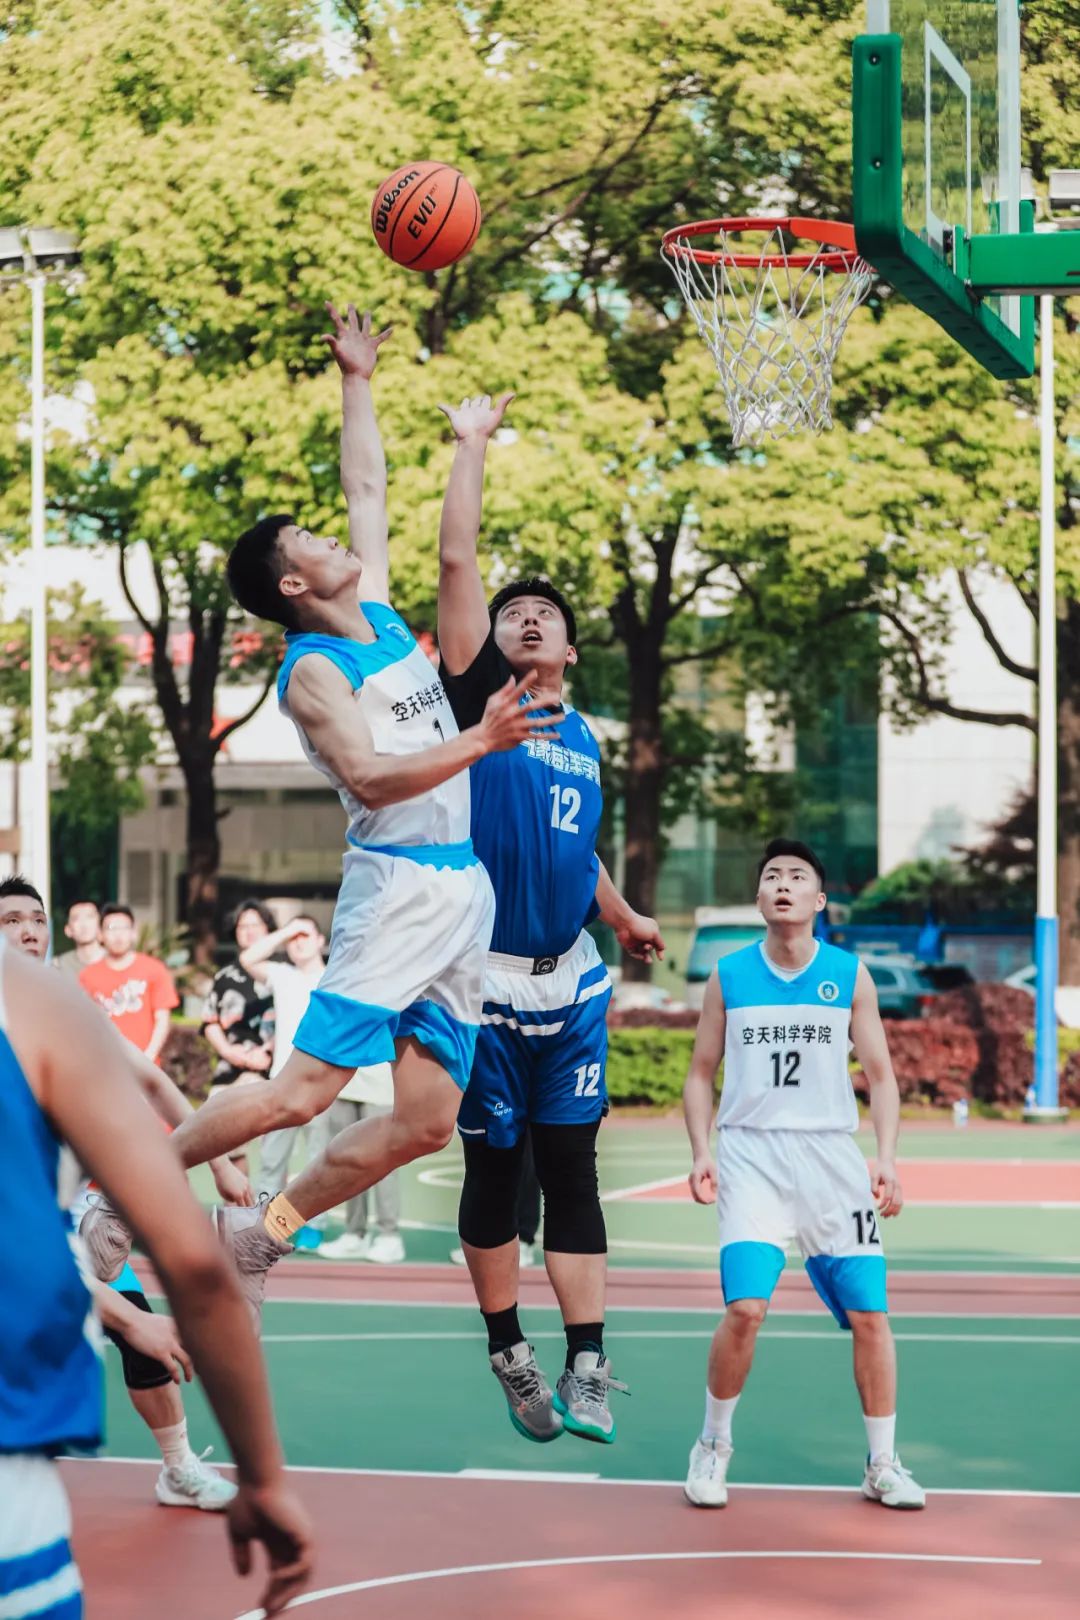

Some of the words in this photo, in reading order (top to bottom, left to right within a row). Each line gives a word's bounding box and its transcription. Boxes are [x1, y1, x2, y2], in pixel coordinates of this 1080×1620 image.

[375, 170, 420, 233] Wilson
[549, 784, 582, 834] 12
[742, 1024, 832, 1045] 空天科学学院
[574, 1063, 600, 1097] 12
[770, 1051, 800, 1087] 12
[852, 1210, 880, 1244] 12
